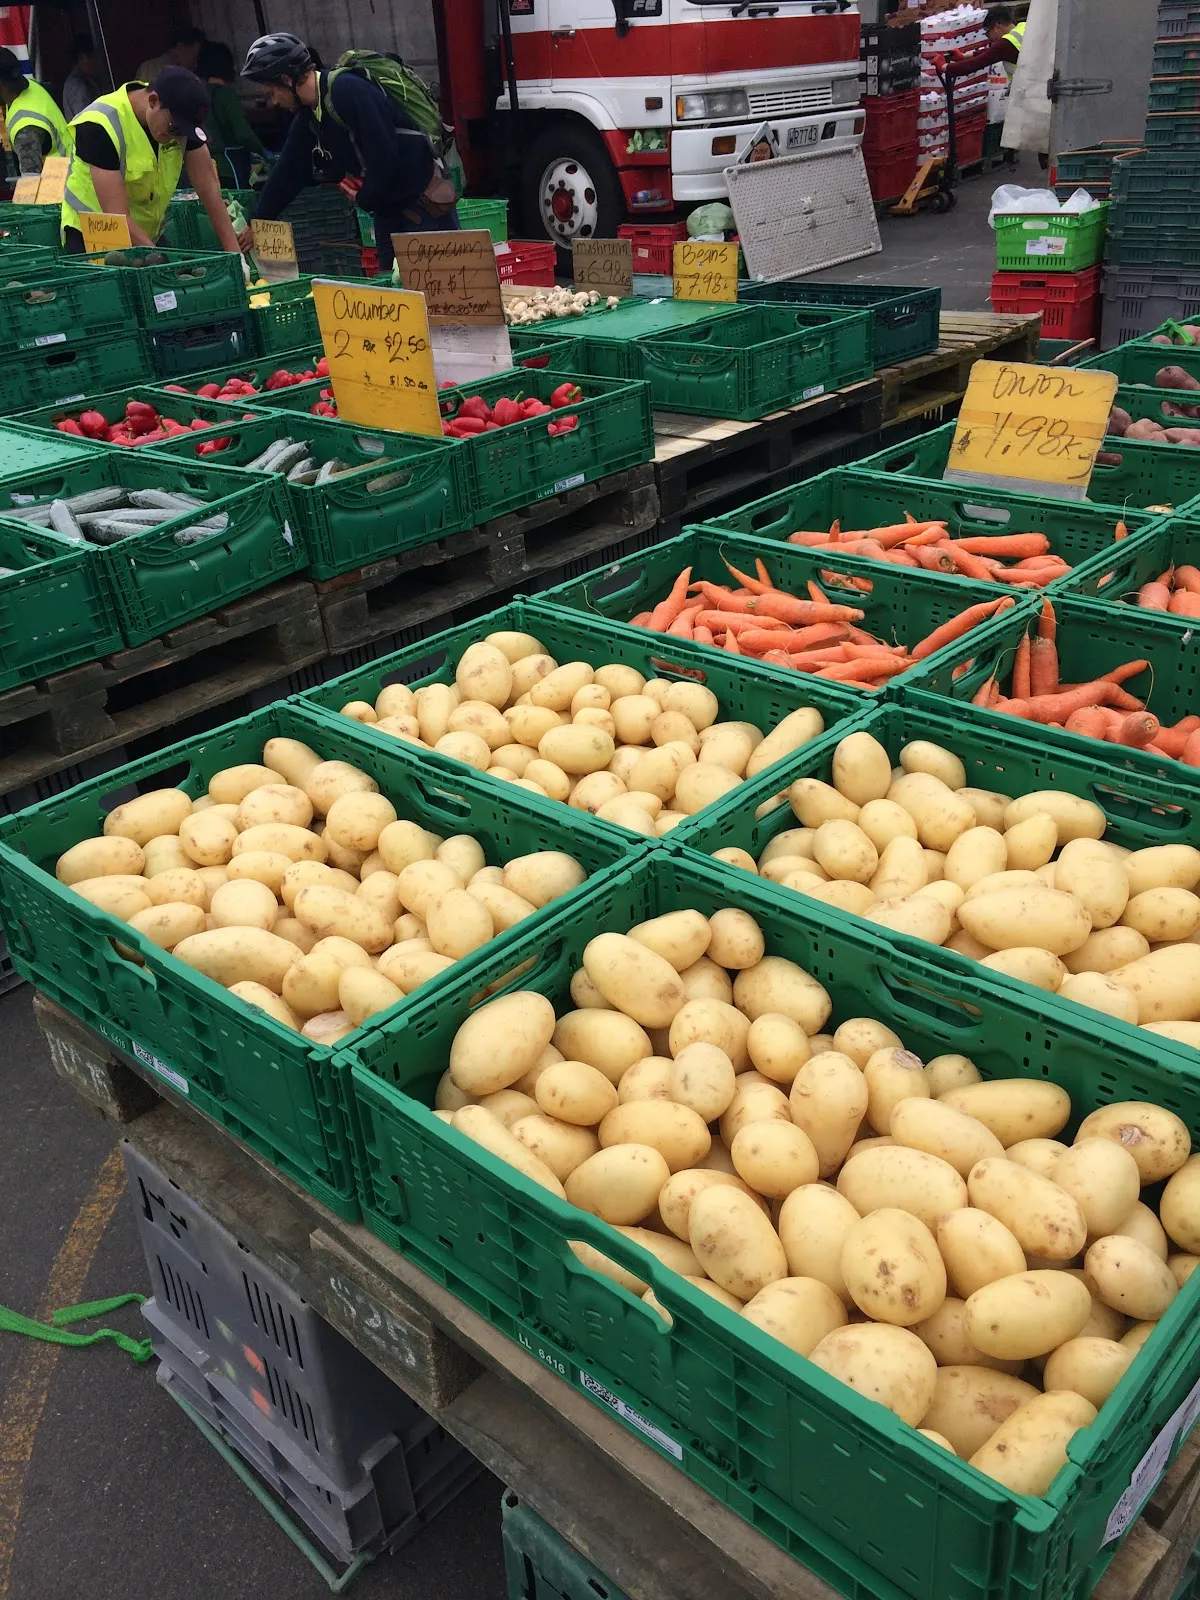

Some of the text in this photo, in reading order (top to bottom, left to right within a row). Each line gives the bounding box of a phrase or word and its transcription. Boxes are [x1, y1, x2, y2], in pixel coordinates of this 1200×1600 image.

[683, 244, 728, 265] Beans
[333, 290, 410, 322] Cucumber
[334, 329, 353, 359] 2
[384, 331, 426, 364] $2.50
[519, 1332, 532, 1350] LL
